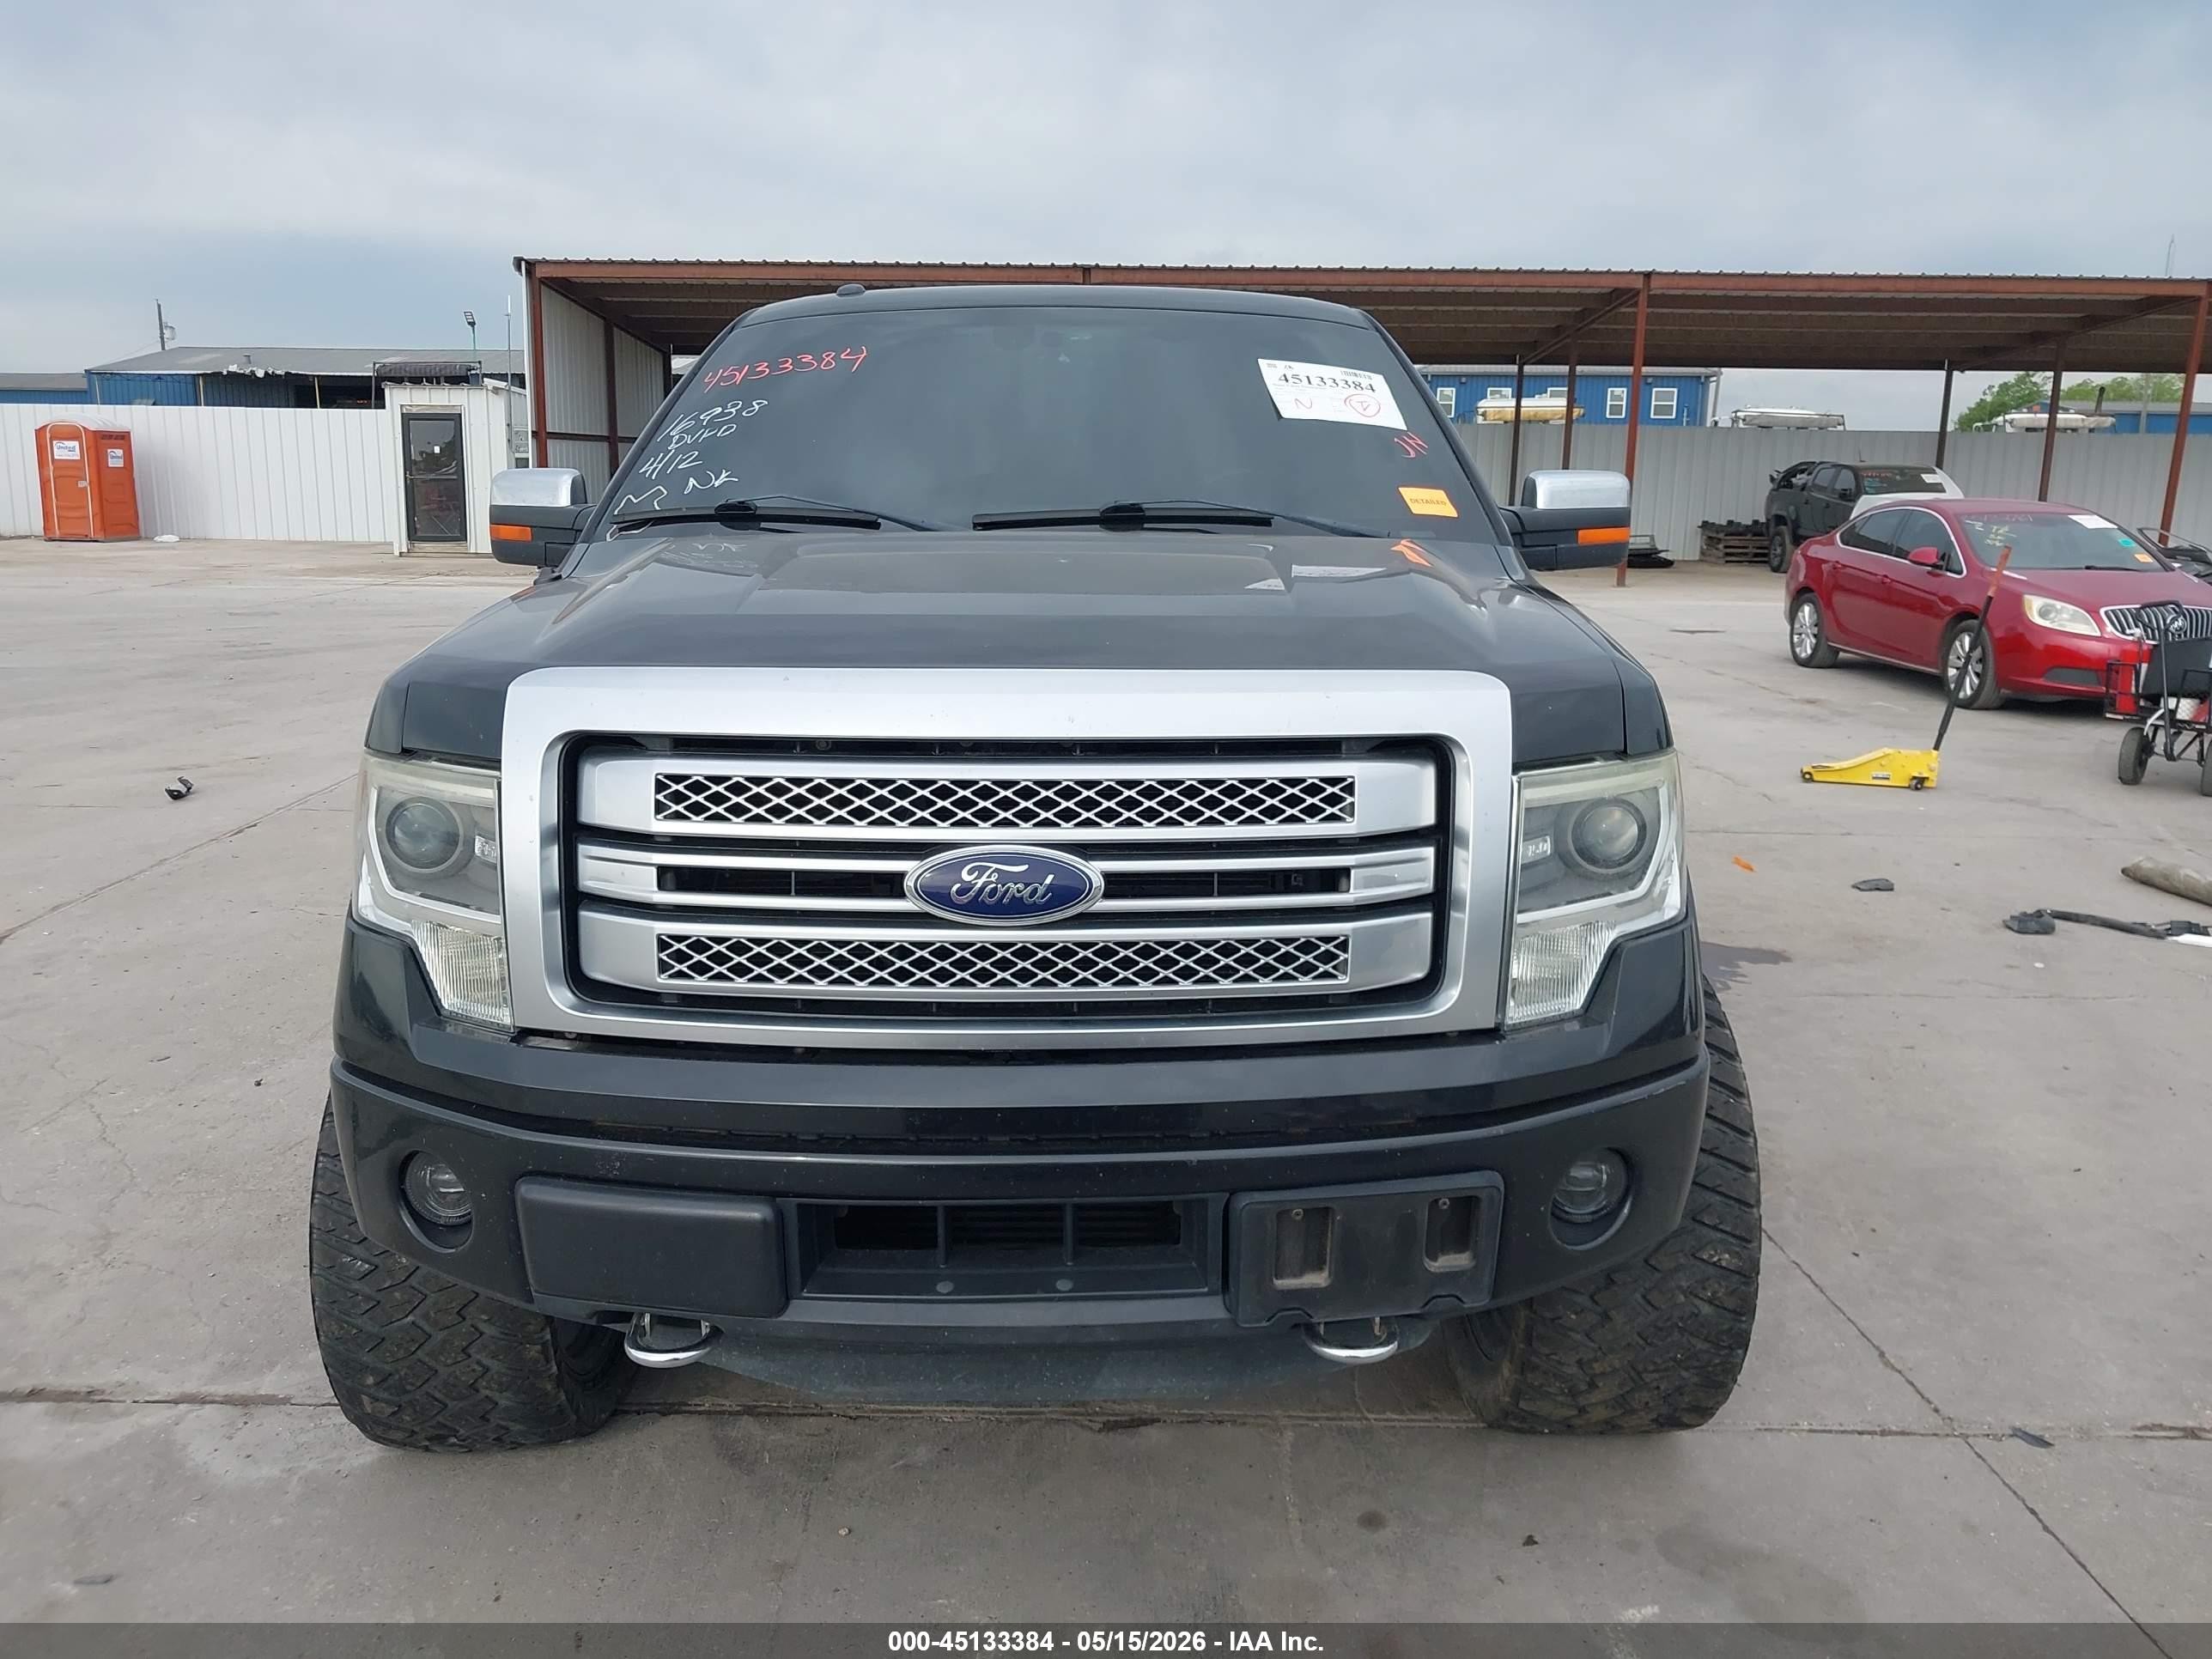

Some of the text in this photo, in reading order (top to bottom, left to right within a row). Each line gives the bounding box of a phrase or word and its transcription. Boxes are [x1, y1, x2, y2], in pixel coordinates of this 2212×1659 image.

[704, 345, 867, 394] 45133384
[1279, 373, 1377, 393] 45133384
[657, 399, 769, 442] 16938
[1409, 497, 1448, 507] DETAILED
[950, 861, 1055, 905] Ford
